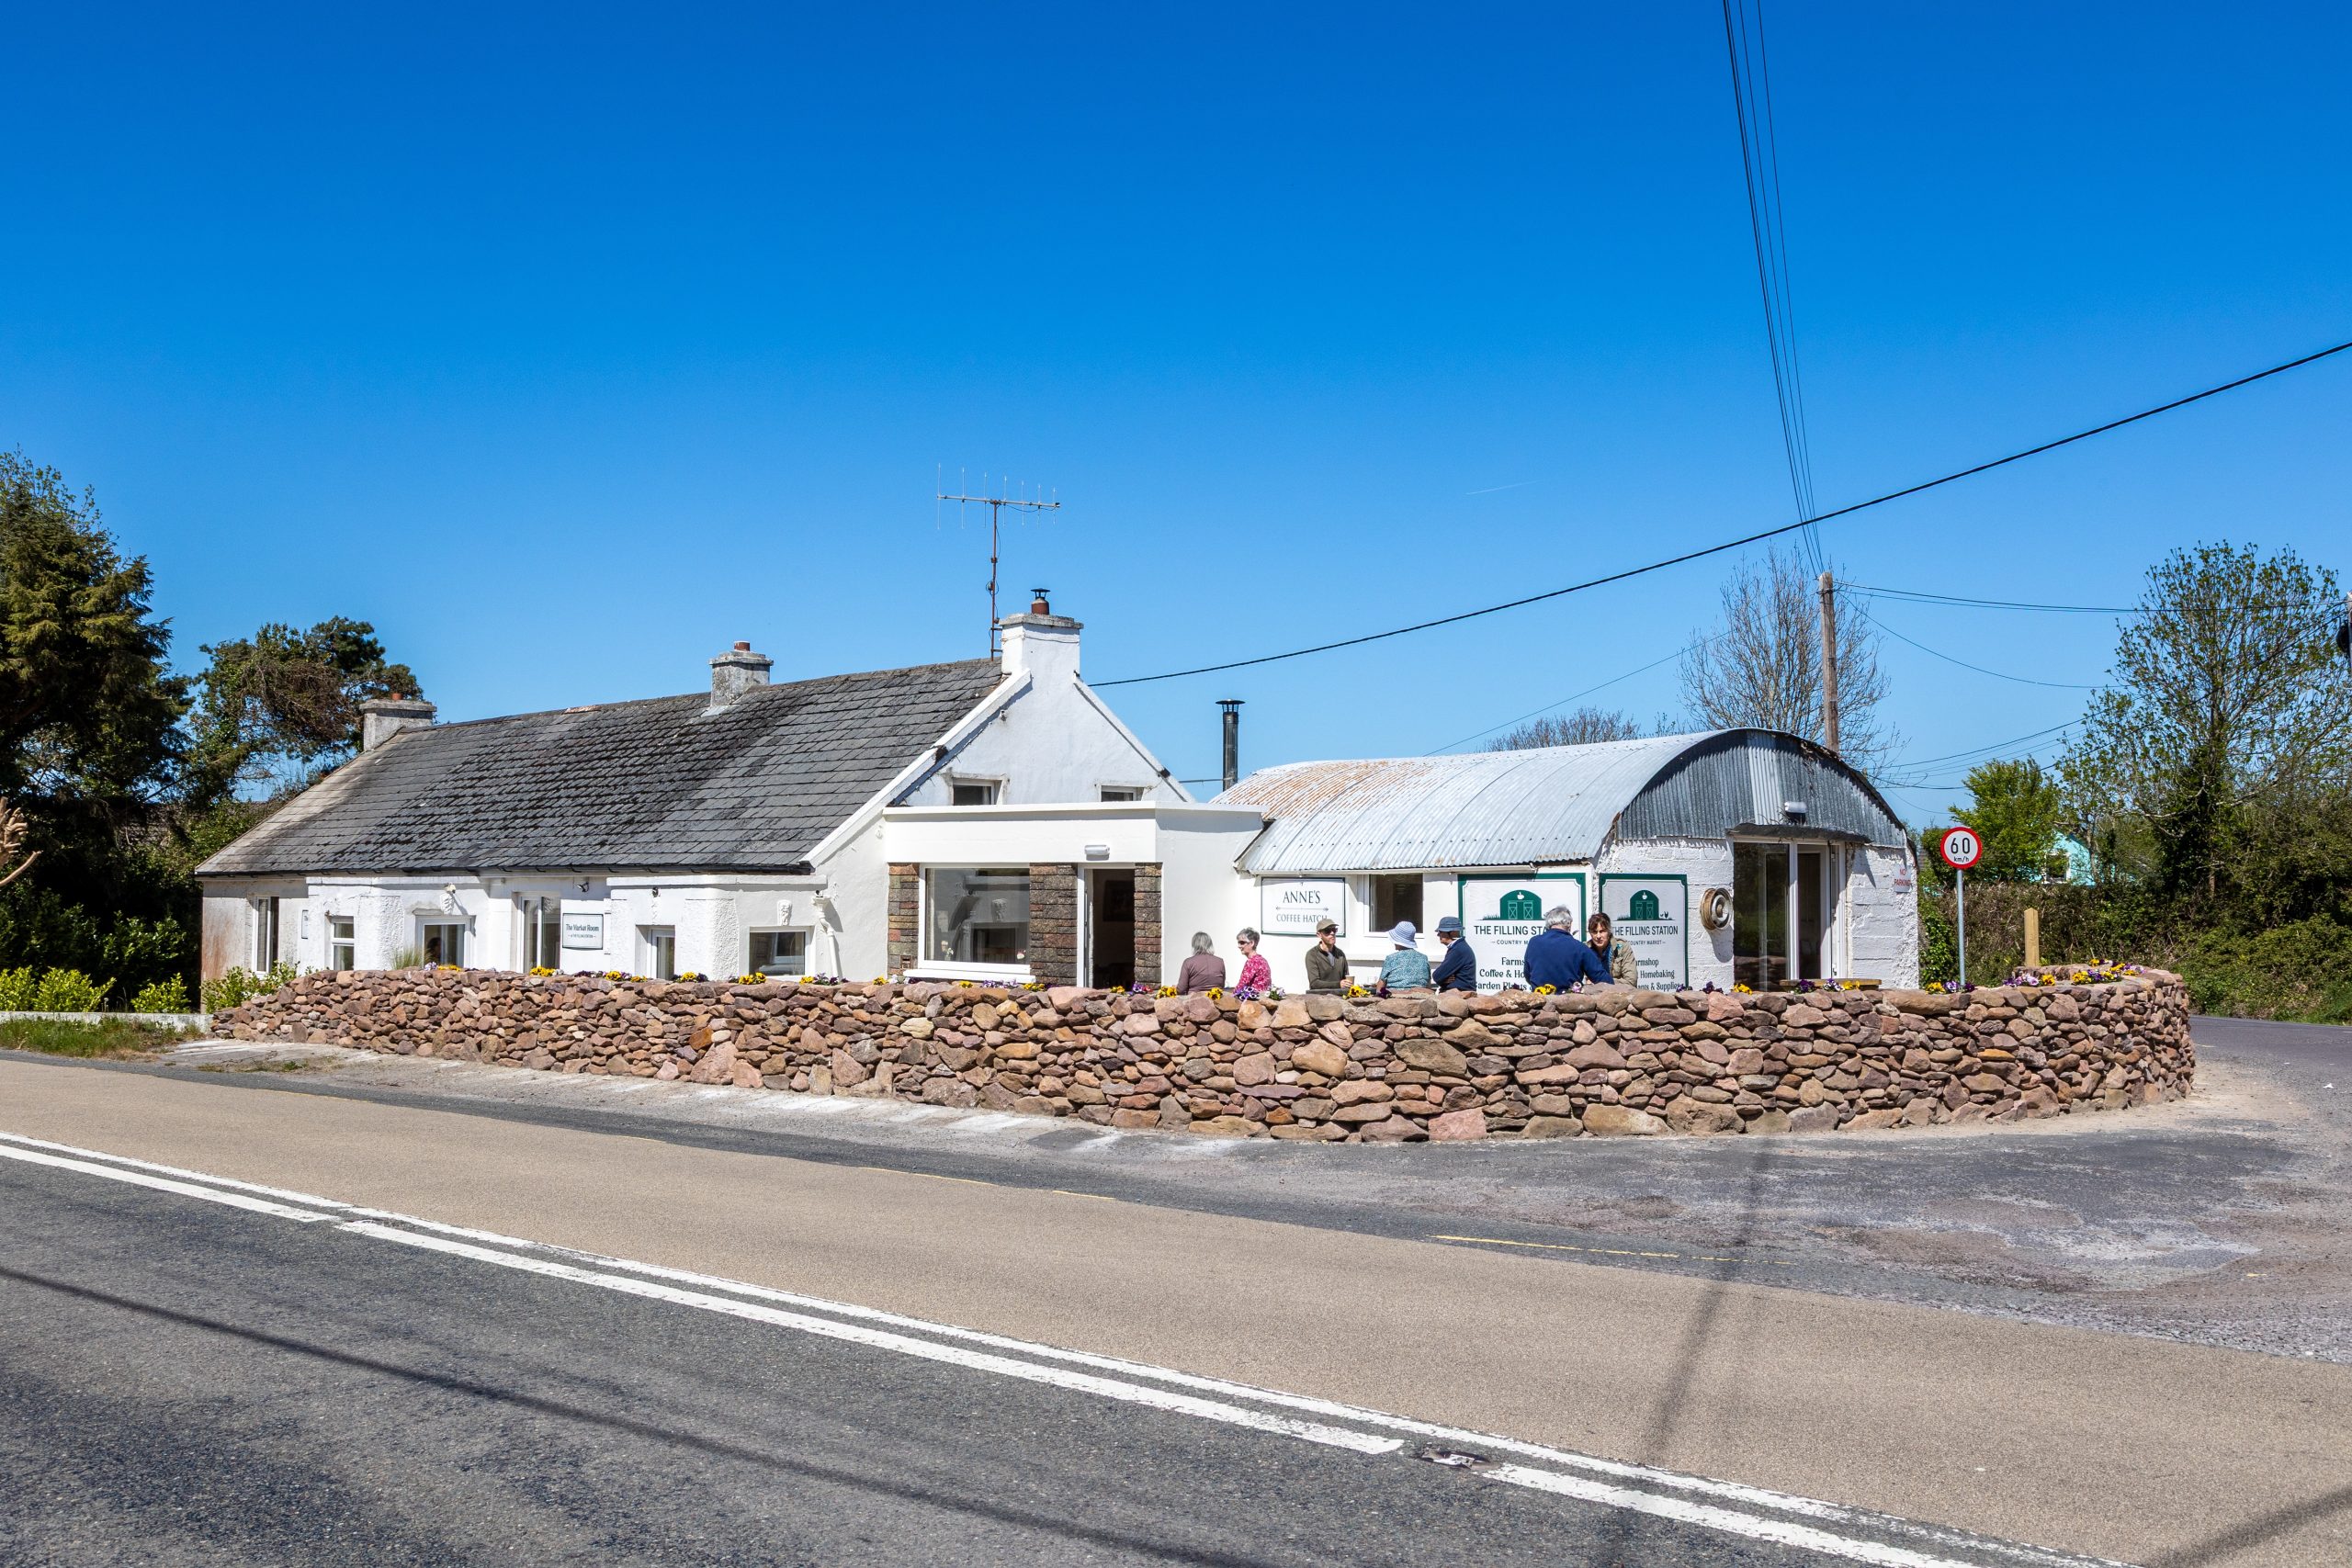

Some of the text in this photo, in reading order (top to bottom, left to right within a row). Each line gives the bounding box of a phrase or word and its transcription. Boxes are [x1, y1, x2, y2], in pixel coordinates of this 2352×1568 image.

[1951, 837, 1971, 854] 60
[1283, 890, 1321, 904] ANNE'S
[1276, 914, 1301, 922] COFFEE
[1474, 925, 1492, 935] THE
[1494, 925, 1529, 935] FILLING
[1625, 926, 1650, 936] FILLING
[1651, 925, 1679, 935] STATION
[1479, 969, 1504, 977] Coffee
[1506, 970, 1512, 978] &
[1640, 969, 1675, 980] Homebaking
[1476, 982, 1501, 990] arden
[1651, 982, 1656, 990] &
